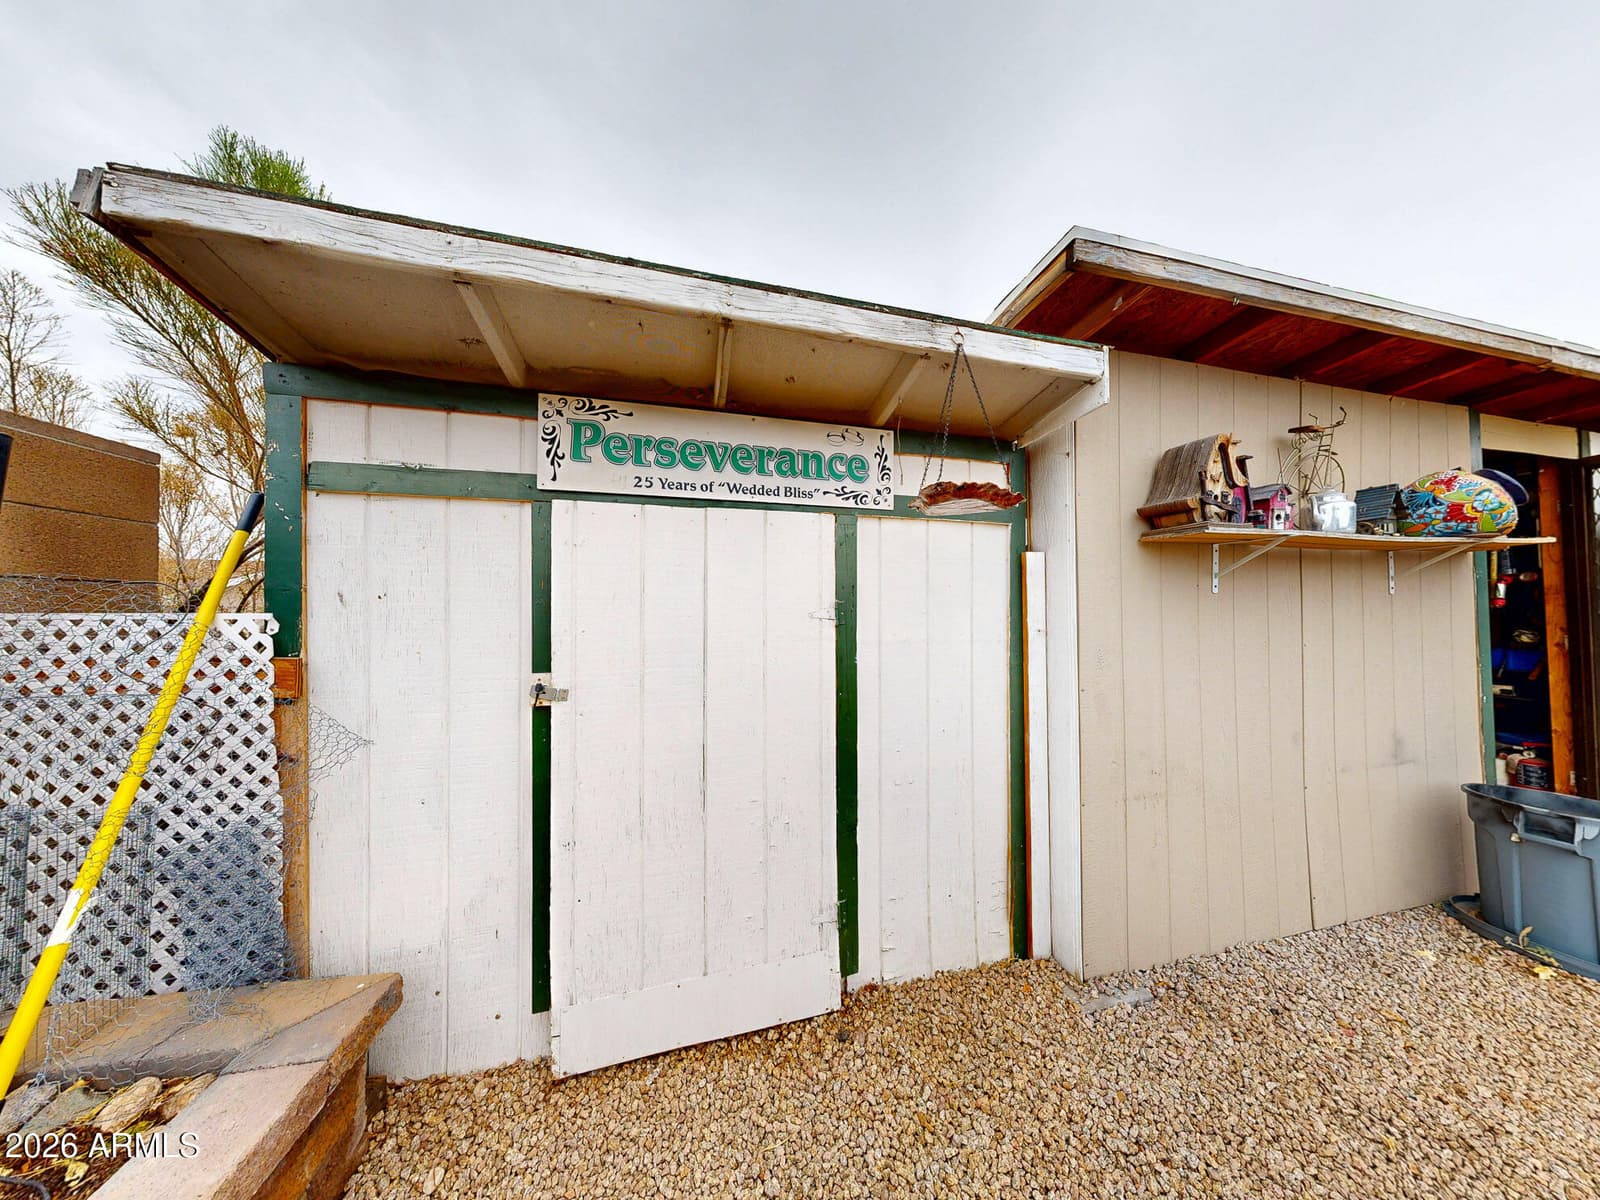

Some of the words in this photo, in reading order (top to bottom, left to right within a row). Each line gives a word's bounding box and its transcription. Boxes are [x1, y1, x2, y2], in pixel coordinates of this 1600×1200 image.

[566, 418, 869, 483] Perseverance
[633, 476, 654, 488] 25
[658, 477, 697, 491] Years
[700, 481, 715, 493] of
[718, 481, 780, 497] “Wedded
[784, 486, 820, 500] Bliss”
